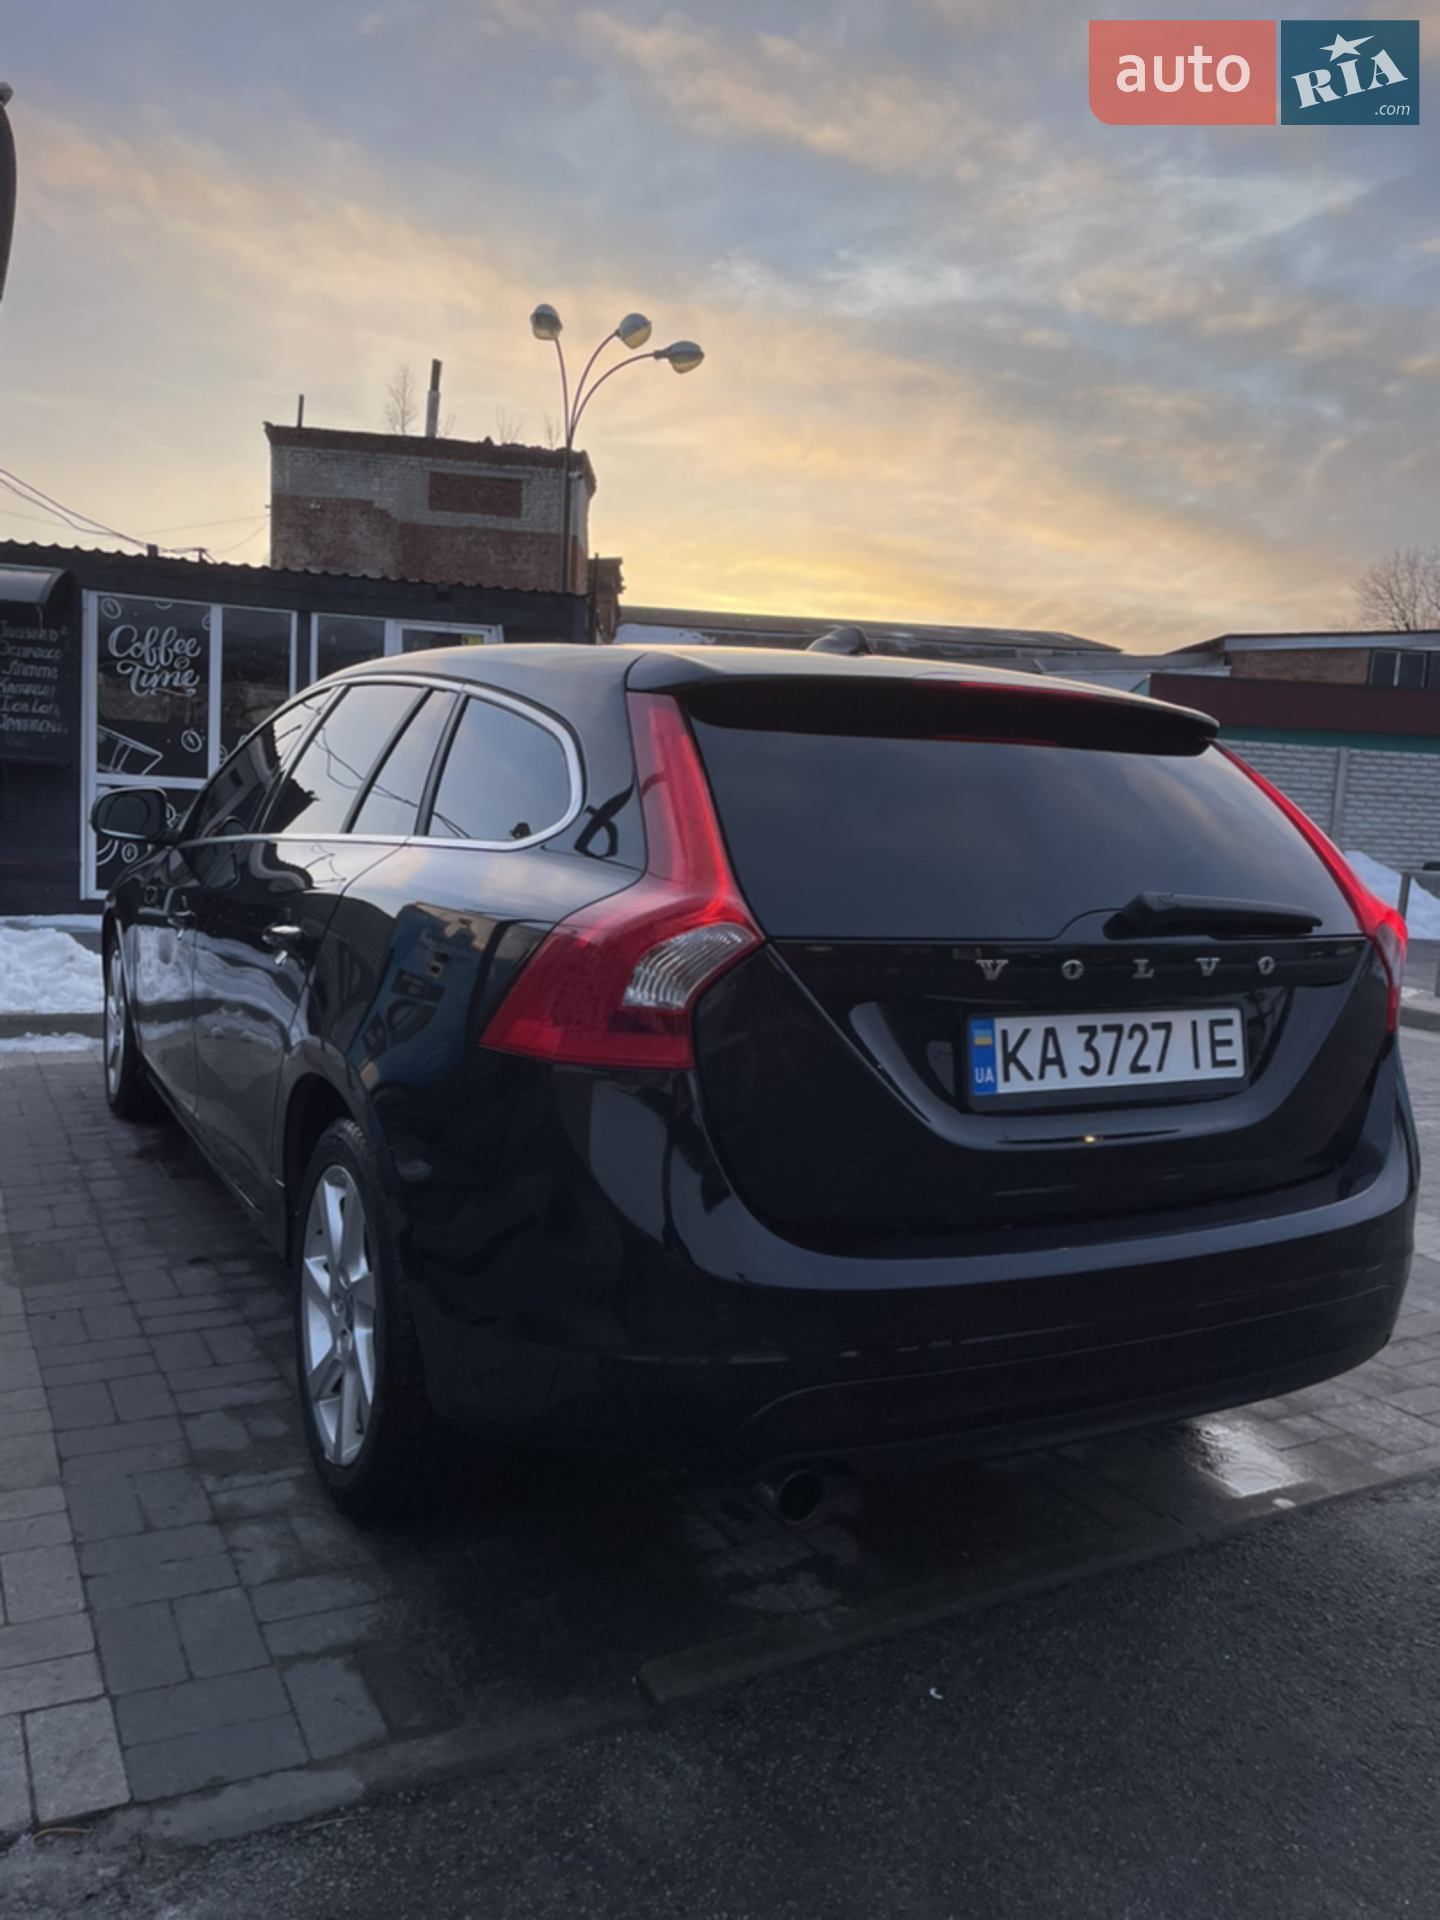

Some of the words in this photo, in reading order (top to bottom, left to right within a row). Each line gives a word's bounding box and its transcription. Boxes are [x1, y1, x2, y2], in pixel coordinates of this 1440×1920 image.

[108, 625, 201, 667] Coffee
[116, 660, 200, 697] Time
[976, 956, 1276, 981] VOLVO
[1001, 1026, 1067, 1083] KA
[1077, 1021, 1173, 1077] 3727
[1191, 1018, 1238, 1069] IE
[974, 1067, 995, 1084] UA
